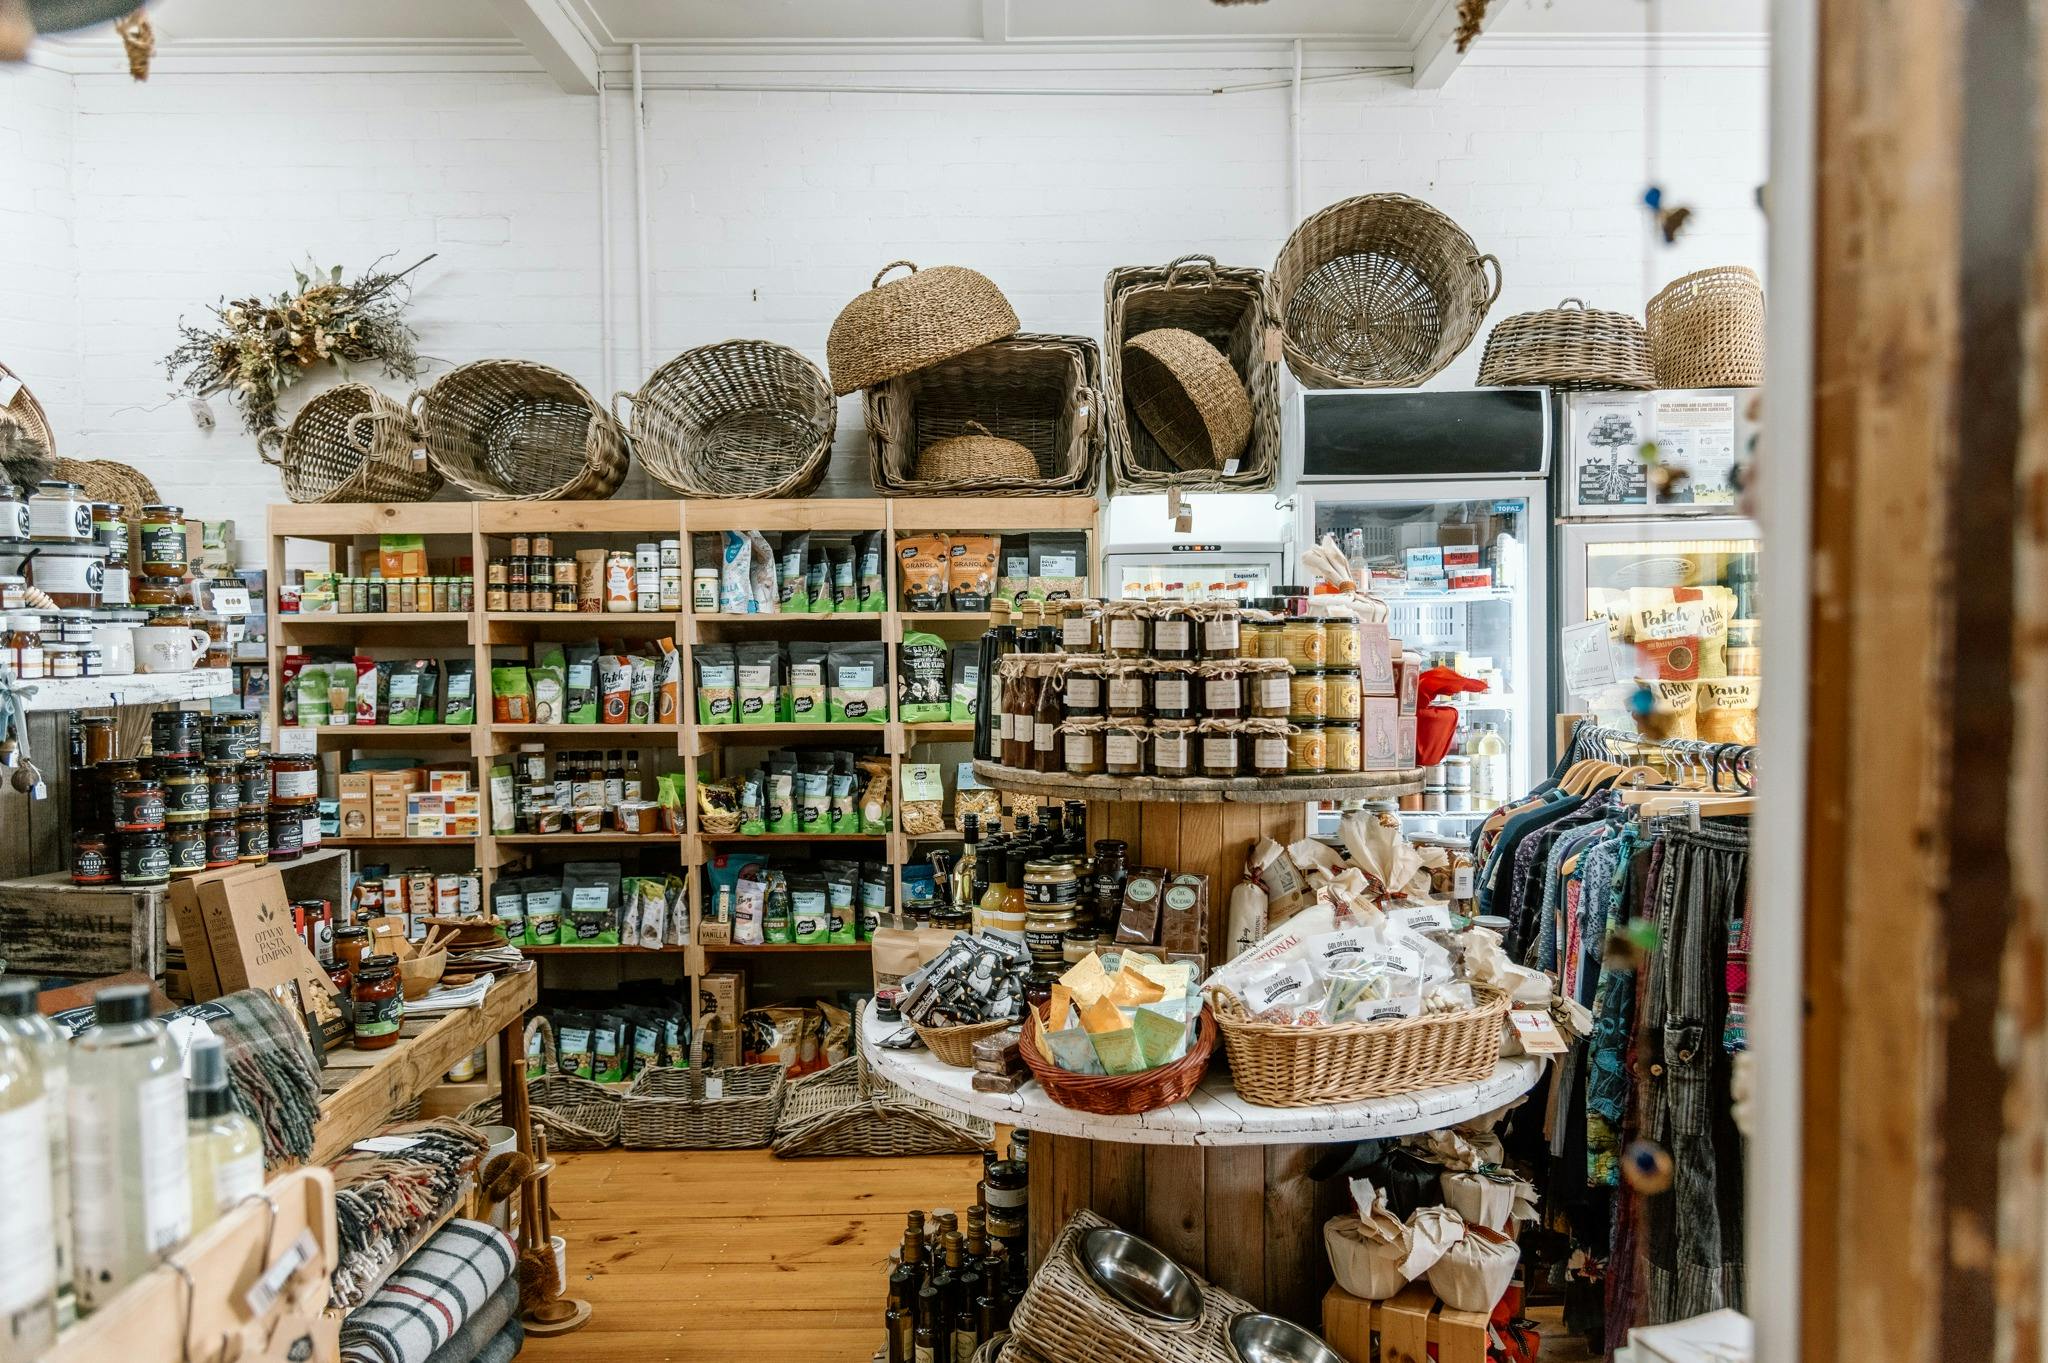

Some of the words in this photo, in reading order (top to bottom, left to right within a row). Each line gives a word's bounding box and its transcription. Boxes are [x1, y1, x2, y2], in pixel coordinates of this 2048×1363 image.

[1641, 606, 1690, 628] Patch
[1650, 624, 1687, 638] Organic
[602, 669, 624, 684] Patch
[631, 669, 647, 684] atch
[1659, 681, 1692, 700] Patch
[1407, 915, 1434, 924] GOLDFIELDS
[253, 926, 284, 944] OTWAY
[702, 931, 728, 939] VANILLA
[258, 937, 288, 954] PASTA
[1327, 938, 1358, 951] GOLDFIELDS
[255, 945, 293, 967] COMPANY
[1264, 976, 1294, 995] GOLDFIELDS
